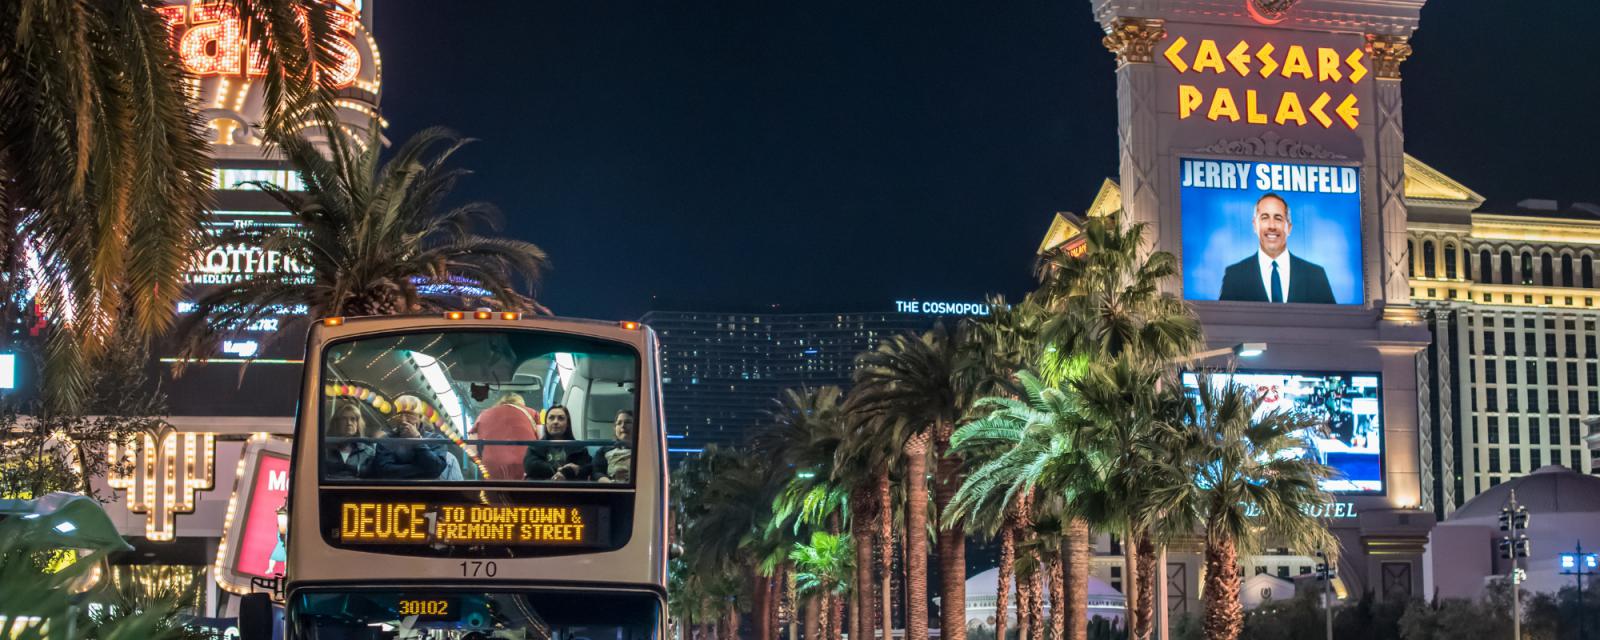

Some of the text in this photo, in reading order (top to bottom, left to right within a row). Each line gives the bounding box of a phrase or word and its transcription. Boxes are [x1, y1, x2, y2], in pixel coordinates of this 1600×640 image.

[1164, 36, 1369, 84] CAESARS
[1177, 84, 1361, 130] PALACE
[1182, 160, 1357, 194] JERRY SEINFELD
[896, 301, 1011, 316] THE COSMOPOLI
[342, 503, 426, 539] DEUCE
[442, 507, 581, 523] TO DOWNTOWN &
[437, 523, 584, 541] FREMONT STREET
[459, 561, 497, 578] 170
[399, 600, 448, 615] 30102
